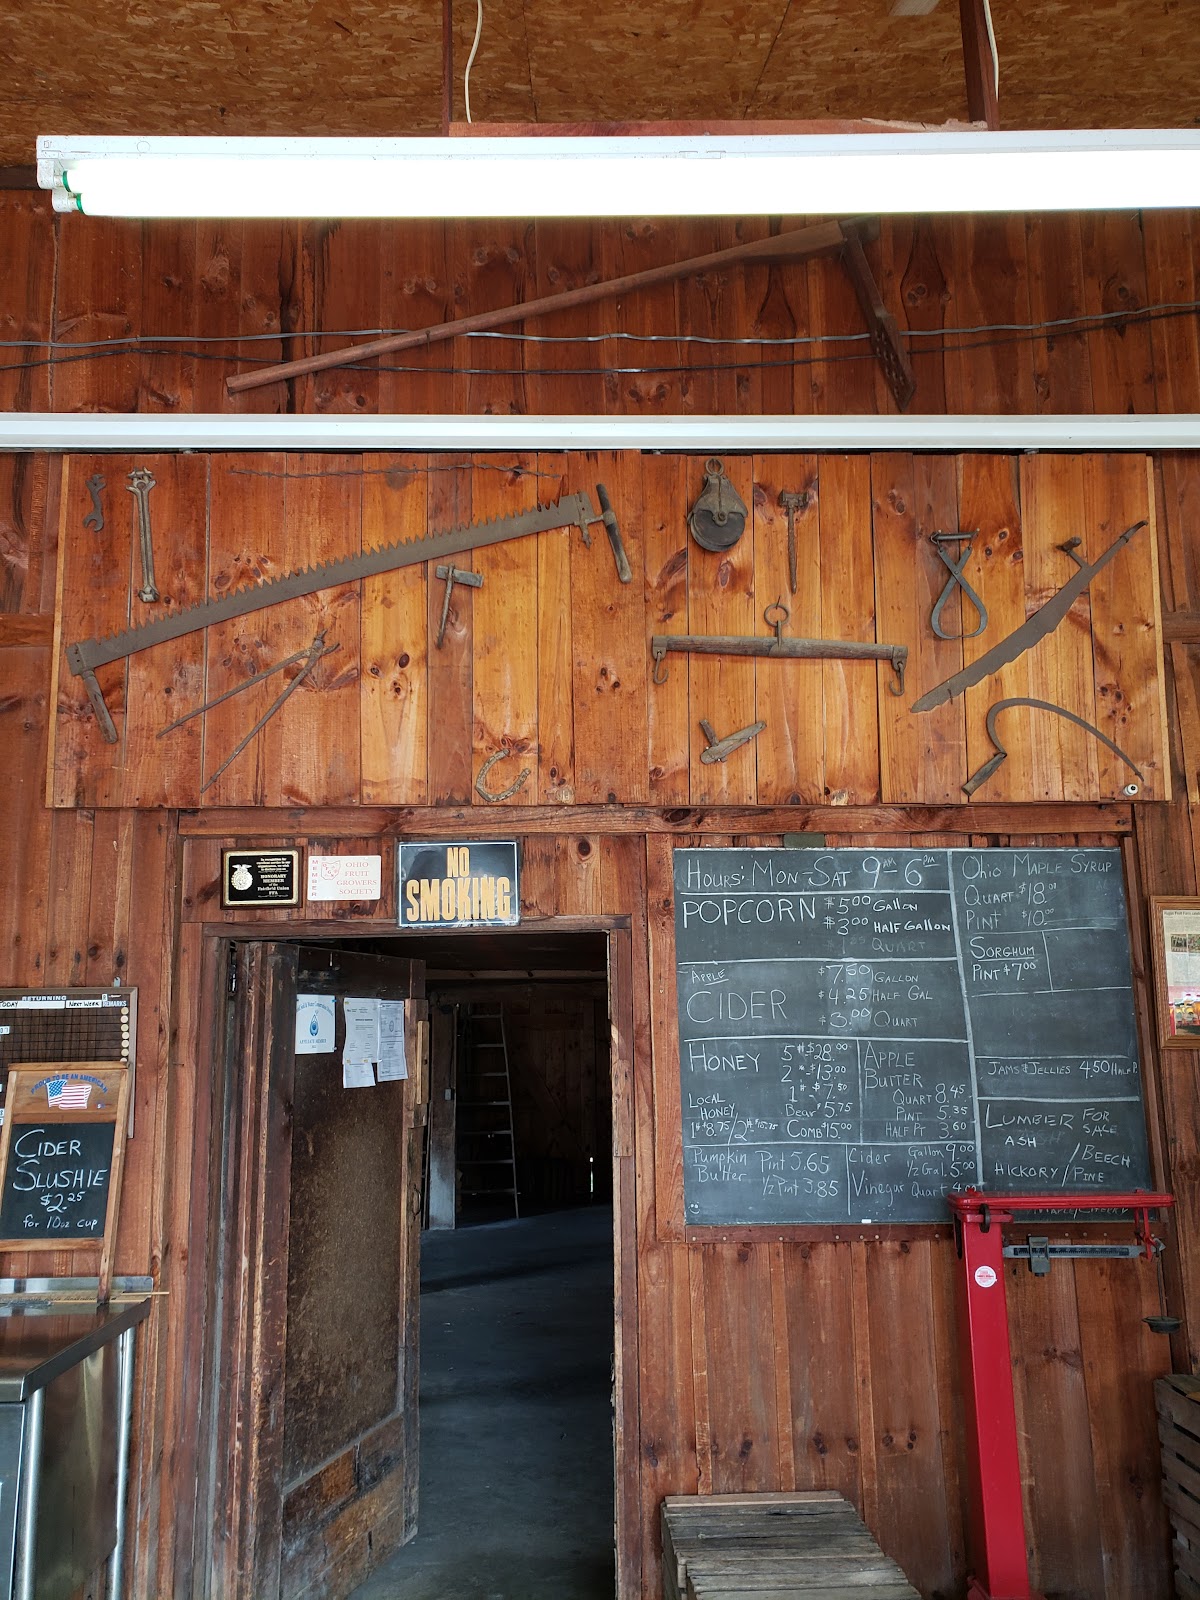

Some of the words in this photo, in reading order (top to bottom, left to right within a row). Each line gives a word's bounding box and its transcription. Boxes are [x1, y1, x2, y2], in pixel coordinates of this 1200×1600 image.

[345, 861, 369, 869] OHIO
[447, 847, 470, 878] NO
[962, 854, 1002, 880] Ohio
[1012, 853, 1062, 877] MAPLE
[1070, 853, 1112, 873] SYRUP
[406, 877, 511, 921] SMOKING
[964, 884, 1014, 906] QUART
[683, 896, 816, 928] POPCORN
[872, 937, 926, 953] QUART
[969, 936, 1035, 959] SORGHUM
[691, 968, 725, 985] APPLE
[972, 963, 1001, 981] PINT
[687, 989, 788, 1023] CIDER
[873, 1010, 918, 1027] QUART
[689, 1044, 760, 1072] HONEY
[864, 1041, 915, 1070] APPLE
[988, 1061, 1020, 1076] JAMS
[1027, 1061, 1072, 1076] JELLIES
[79, 1074, 109, 1094] AMERICAN
[864, 1068, 923, 1090] BUTTER
[688, 1092, 726, 1108] LOCAL
[892, 1088, 933, 1106] QUART
[700, 1103, 736, 1120] HONEY
[896, 1106, 923, 1122] PINT
[985, 1103, 1074, 1130] LUMBER
[1082, 1107, 1110, 1122] FOR
[787, 1119, 823, 1139] COMB
[885, 1122, 910, 1138] HALF
[1082, 1123, 1118, 1137] SALE
[15, 1129, 82, 1158] CIDER
[1004, 1135, 1037, 1148] ASH
[692, 1147, 747, 1171] Pumpkin
[755, 1150, 786, 1173] Pint
[848, 1147, 891, 1165] Cider
[908, 1145, 945, 1160] Gallon
[1082, 1144, 1131, 1168] BEECH
[12, 1159, 108, 1191] SLUSHIE
[692, 1164, 747, 1183] Butter
[773, 1174, 799, 1196] Pint
[993, 1161, 1059, 1179] HICKORY
[851, 1170, 905, 1206] Vinegar
[911, 1181, 948, 1199] Quart
[23, 1214, 40, 1229] for
[77, 1219, 98, 1231] cup
